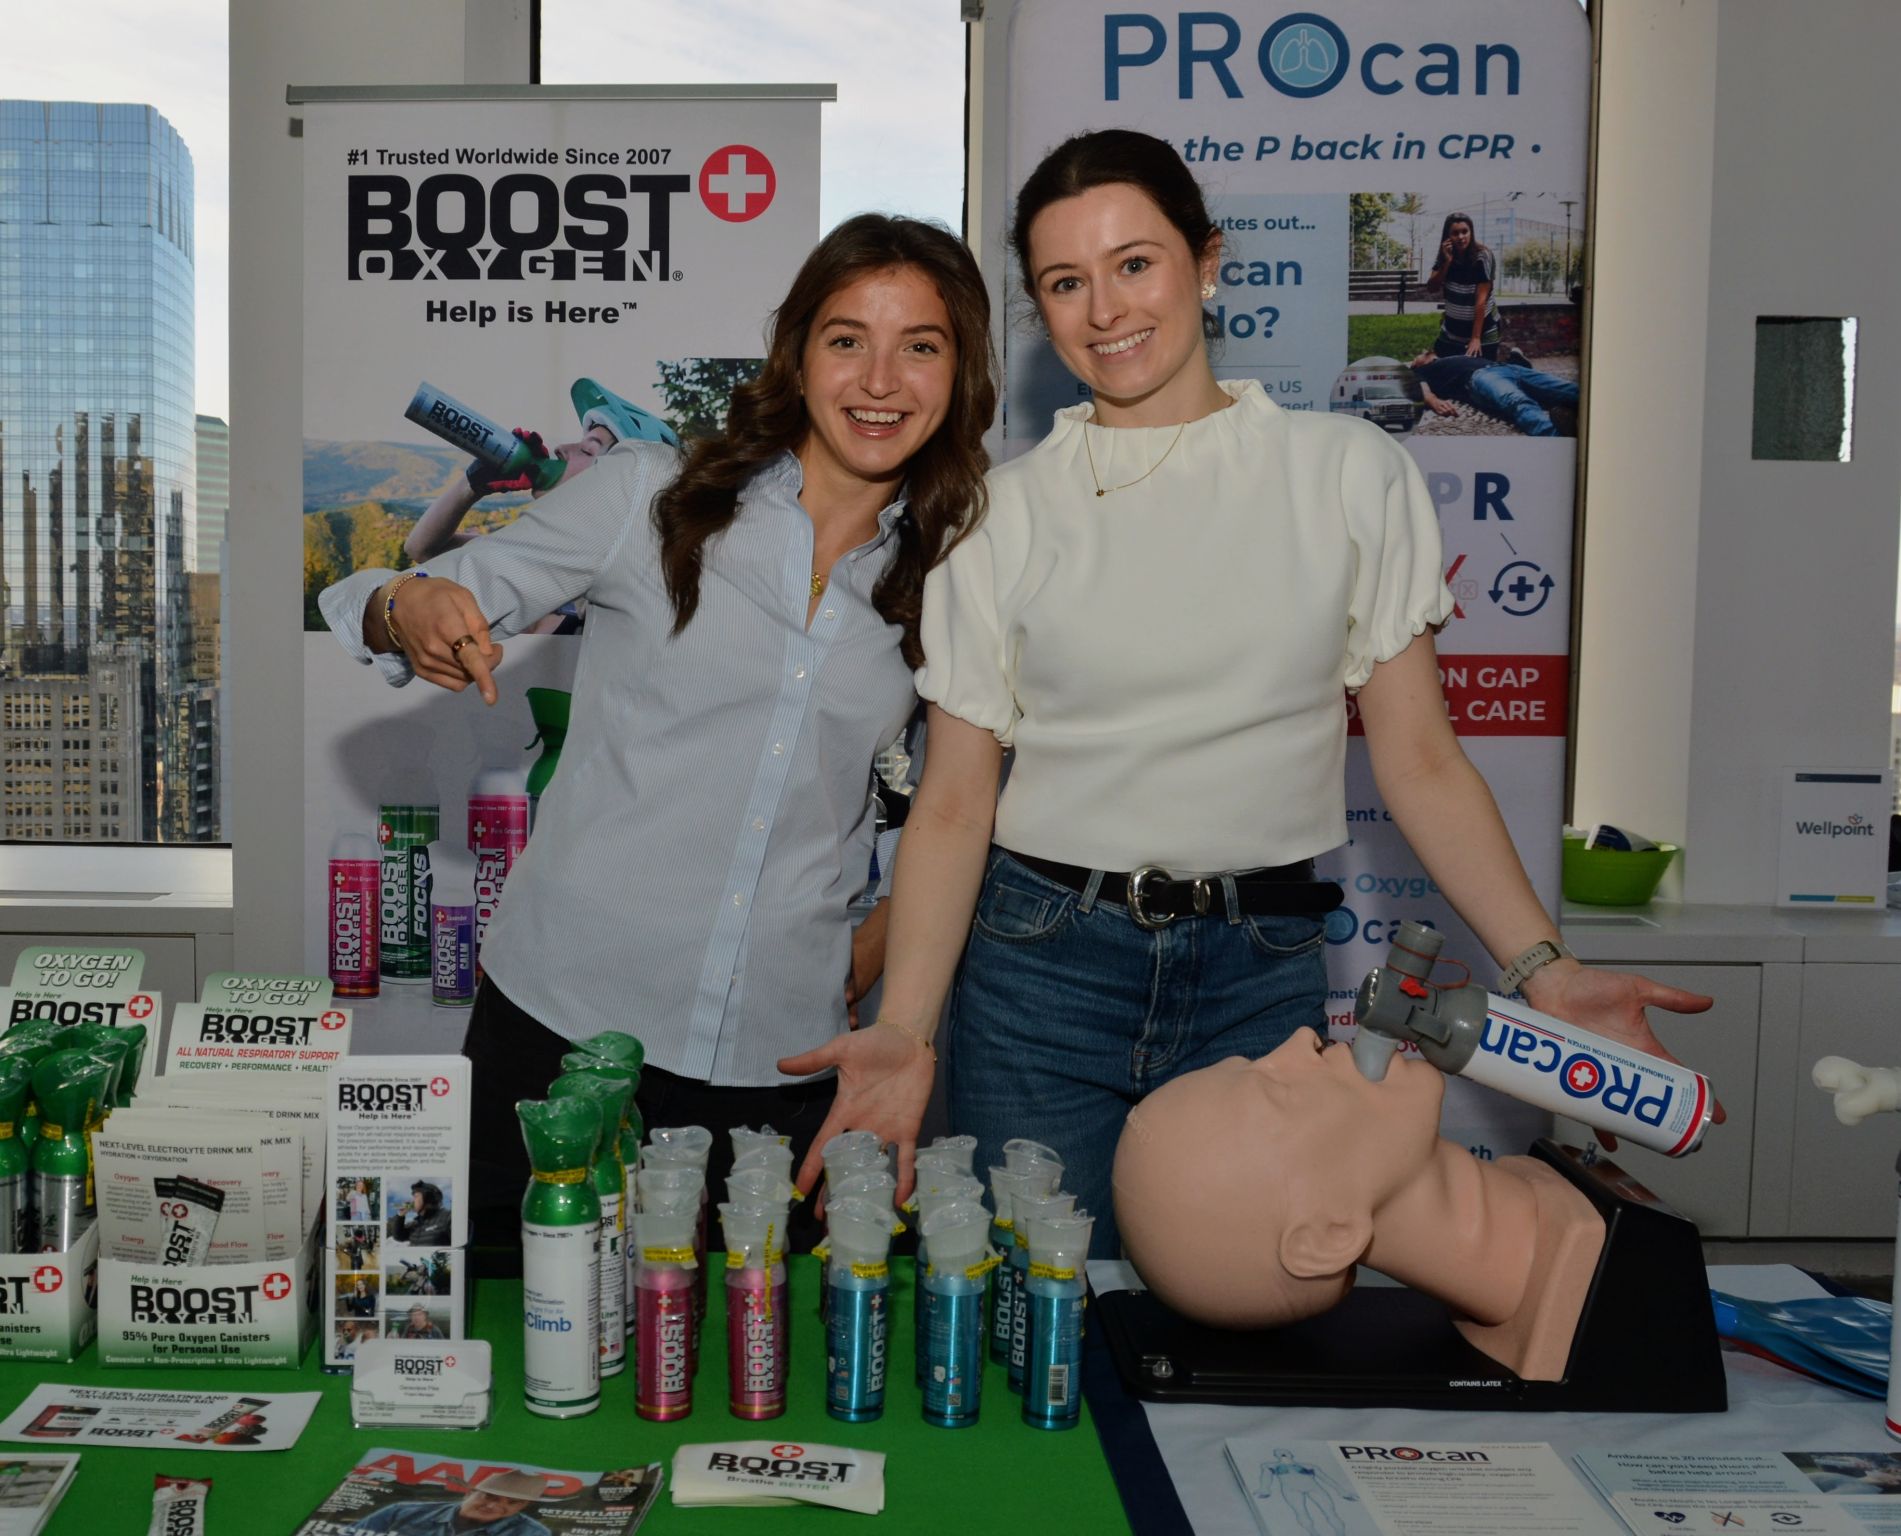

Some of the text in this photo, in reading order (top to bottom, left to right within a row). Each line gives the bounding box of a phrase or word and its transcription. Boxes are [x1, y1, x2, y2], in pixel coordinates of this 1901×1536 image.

[1104, 12, 1520, 100] PROcan
[347, 148, 672, 166] #1 Trusted Worldwide Since 2007
[1184, 135, 1244, 162] the
[1255, 136, 1281, 161] P
[1291, 134, 1380, 161] back
[1393, 133, 1426, 160] in
[1438, 134, 1515, 160] CPR
[347, 173, 691, 254] BOOST
[1264, 215, 1316, 231] out...
[1220, 259, 1303, 287] can
[426, 299, 497, 328] Help
[508, 300, 534, 324] is
[1279, 380, 1303, 394] US
[428, 399, 494, 448] BOOST
[1477, 667, 1541, 689] GAP
[1467, 700, 1547, 722] CARE
[1796, 820, 1875, 839] Wellpoint
[381, 847, 399, 946] BOOST
[1355, 872, 1440, 899] Oxyge
[397, 850, 408, 946] OXYGEN
[335, 887, 352, 972] BOOST
[351, 890, 361, 972] OXYGEN
[34, 953, 134, 971] OXYGEN
[437, 923, 450, 989] BOOST
[459, 942, 470, 971] CALM
[40, 970, 120, 988] TO GO!
[221, 977, 322, 993] OXYGEN
[229, 990, 313, 1006] TO GO!
[9, 1000, 126, 1028] BOOST
[200, 1013, 317, 1038] BOOST
[176, 1046, 339, 1061] ALL NATURAL RESPIRATORY SUPPORT
[179, 1061, 222, 1070] RECOVERY
[231, 1062, 293, 1072] PERFORMANCE
[1478, 1017, 1674, 1128] PROcan
[339, 1083, 428, 1105] BOOST
[303, 1112, 320, 1120] MIX
[359, 1112, 379, 1121] Help
[147, 1146, 205, 1155] ELECTROLYTE
[274, 1137, 292, 1145] MIX
[131, 1274, 150, 1286] Help
[130, 1284, 259, 1315] BOOST
[0, 1324, 41, 1335] anisters
[130, 1313, 257, 1324] OXYGEN
[526, 1313, 572, 1333] Climb
[1011, 1290, 1028, 1368] BOOST
[0, 1336, 12, 1345] se
[122, 1331, 270, 1344] 95% Pure Oxygen Canisters
[153, 1344, 241, 1354] for Personal Use
[660, 1310, 678, 1393] BOOST
[747, 1310, 767, 1393] BOOST
[870, 1311, 887, 1394] BOOST
[394, 1358, 443, 1372] BOOST
[88, 1427, 158, 1438] BOOST
[1338, 1445, 1490, 1462] PROcan
[709, 1451, 856, 1480] BOOST
[726, 1475, 831, 1491] Breathe BETTER
[177, 1498, 198, 1536] BOOS
